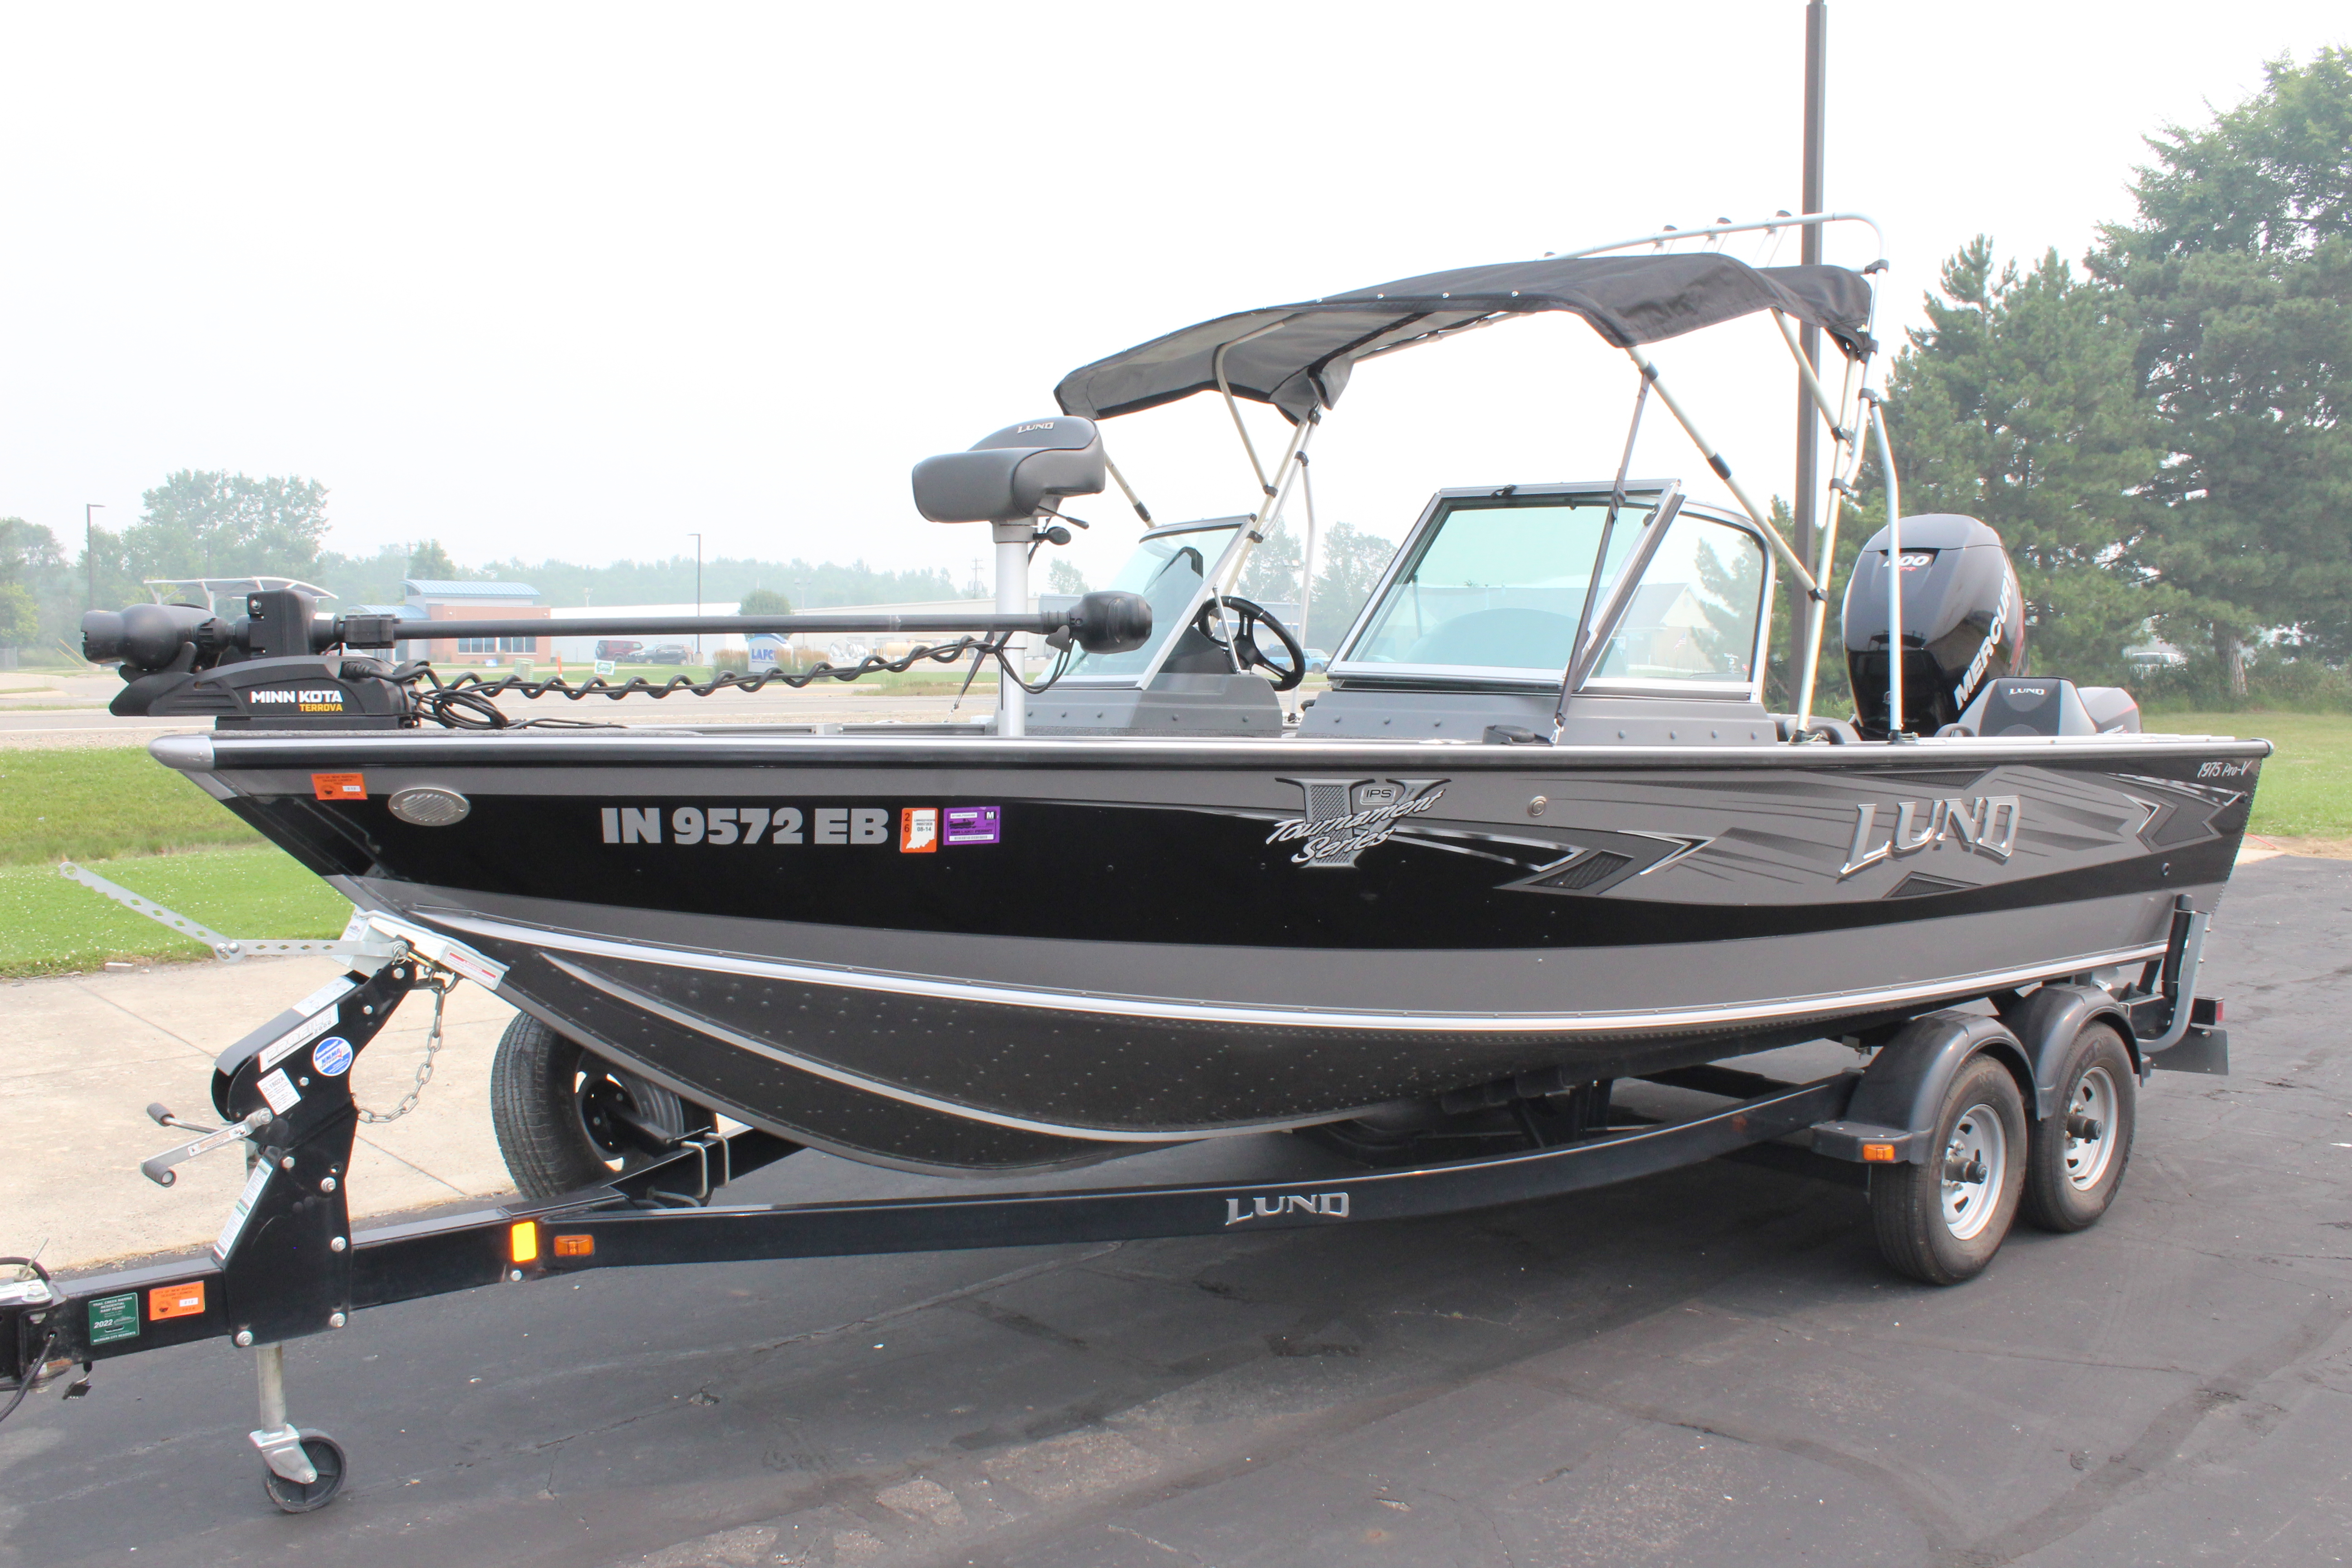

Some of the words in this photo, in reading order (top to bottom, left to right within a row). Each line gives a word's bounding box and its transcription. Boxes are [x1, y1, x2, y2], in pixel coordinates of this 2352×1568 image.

[1017, 422, 1054, 434] LUND
[1954, 557, 2012, 710] MERCURY
[251, 691, 296, 703] MINN
[299, 690, 343, 703] KOTA
[299, 704, 343, 712] TERROVA
[2197, 762, 2223, 778] 1975
[2221, 760, 2253, 777] Pro-V
[1366, 789, 1392, 798] IPS
[986, 811, 995, 819] M
[1265, 789, 1447, 845] Tournament
[601, 808, 662, 843] IN
[672, 807, 803, 845] 9572
[815, 808, 889, 844] EB
[1838, 794, 2021, 876] LUND
[1291, 828, 1396, 863] Series
[266, 1010, 332, 1063] PROFILE
[263, 1076, 285, 1093] DL1802A
[1225, 1192, 1349, 1225] LUND
[93, 1319, 113, 1329] 2022
